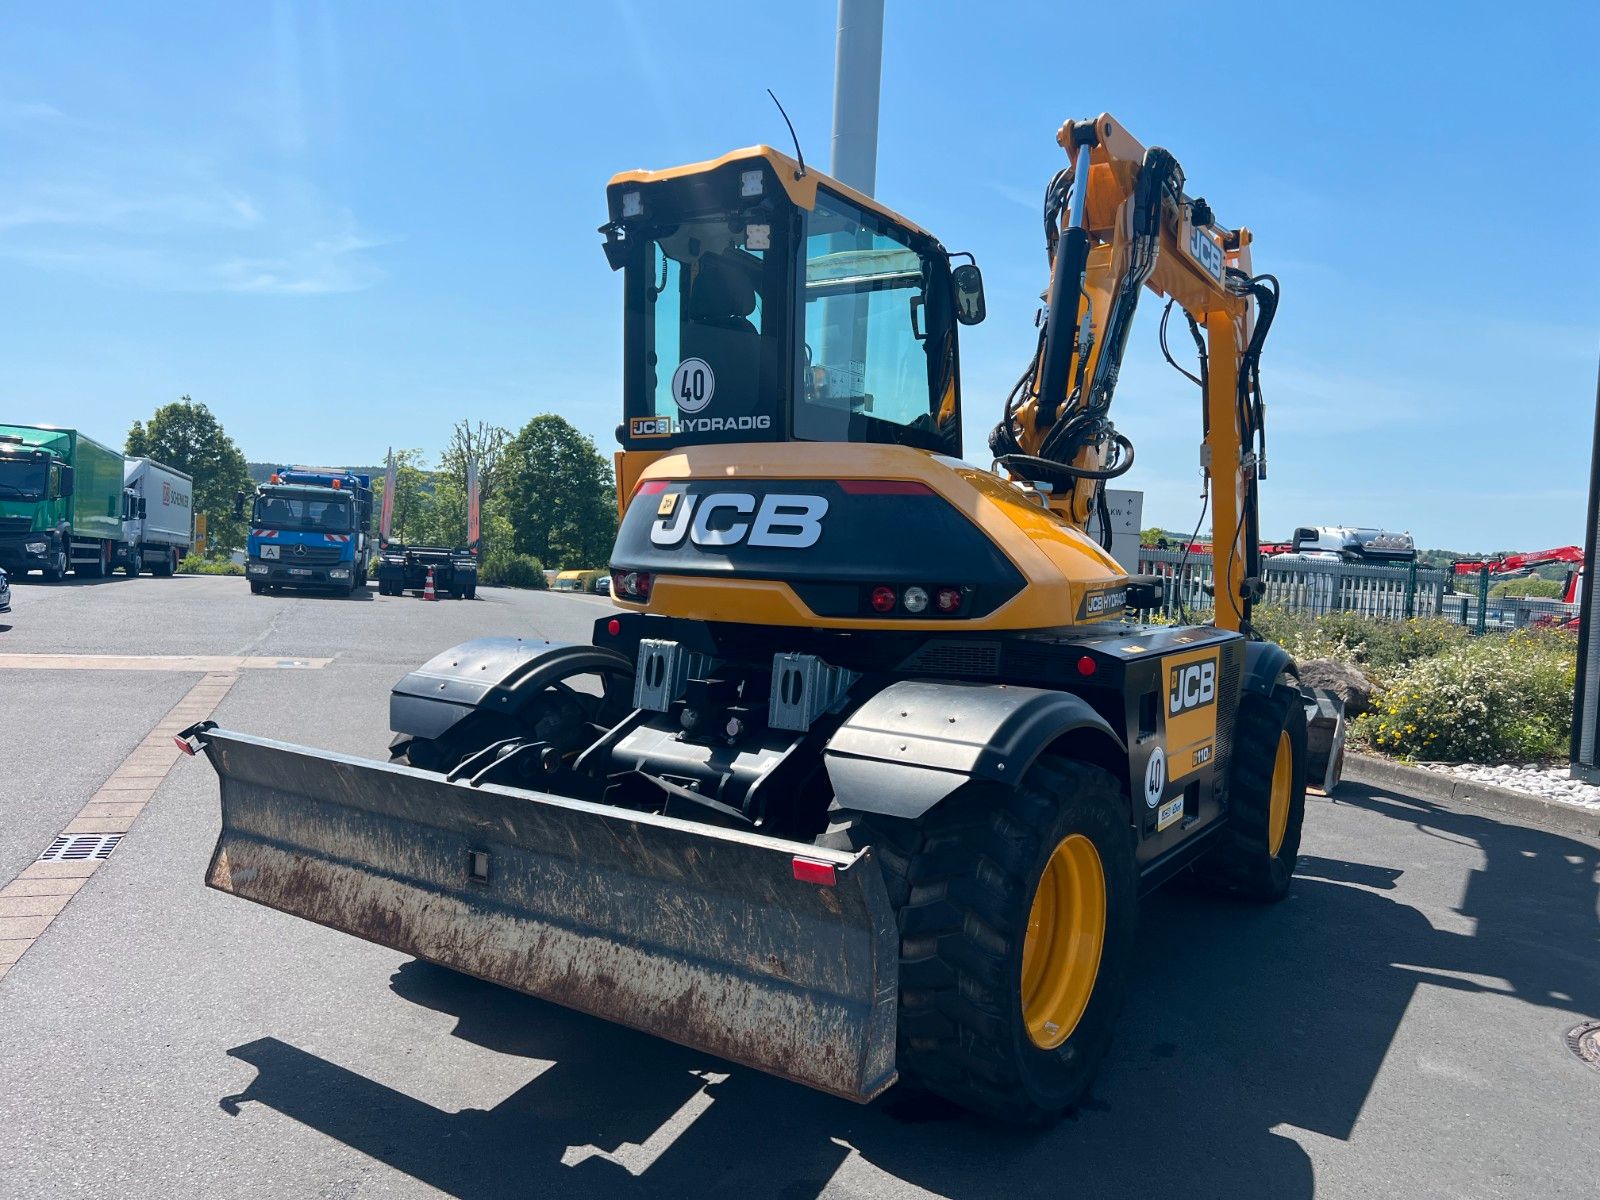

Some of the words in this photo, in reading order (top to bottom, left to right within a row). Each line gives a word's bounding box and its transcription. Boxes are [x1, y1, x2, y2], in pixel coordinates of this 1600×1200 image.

[1191, 228, 1220, 279] JCB
[681, 369, 704, 401] 40
[634, 421, 668, 434] JCB
[673, 415, 771, 432] HYDRADIG
[650, 493, 829, 548] JCB
[265, 548, 275, 557] A
[1089, 596, 1103, 612] JCB
[1170, 662, 1215, 713] JCB
[1197, 747, 1209, 764] 110
[1149, 759, 1161, 795] 40
